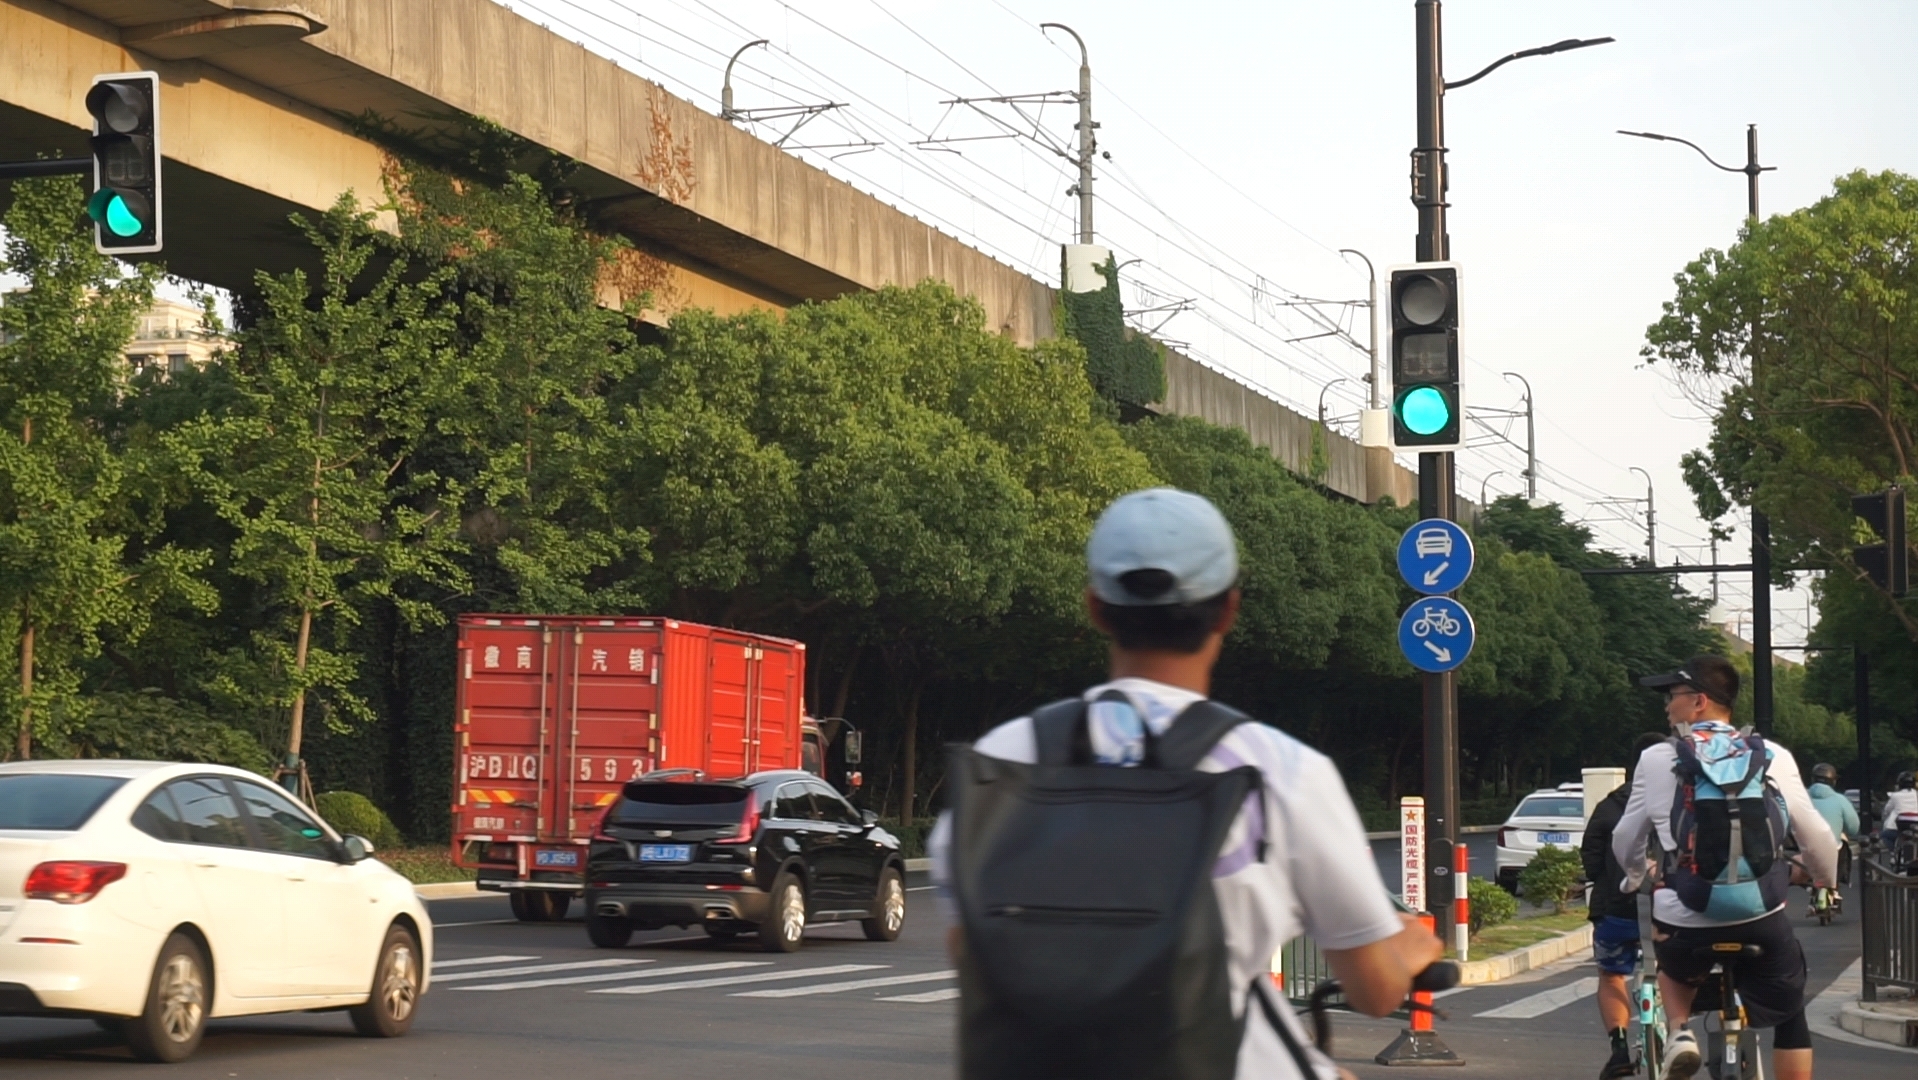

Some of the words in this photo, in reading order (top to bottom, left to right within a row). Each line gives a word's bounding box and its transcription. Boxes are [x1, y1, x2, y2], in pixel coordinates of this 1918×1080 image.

[1405, 824, 1419, 911] 国防光缆严禁开
